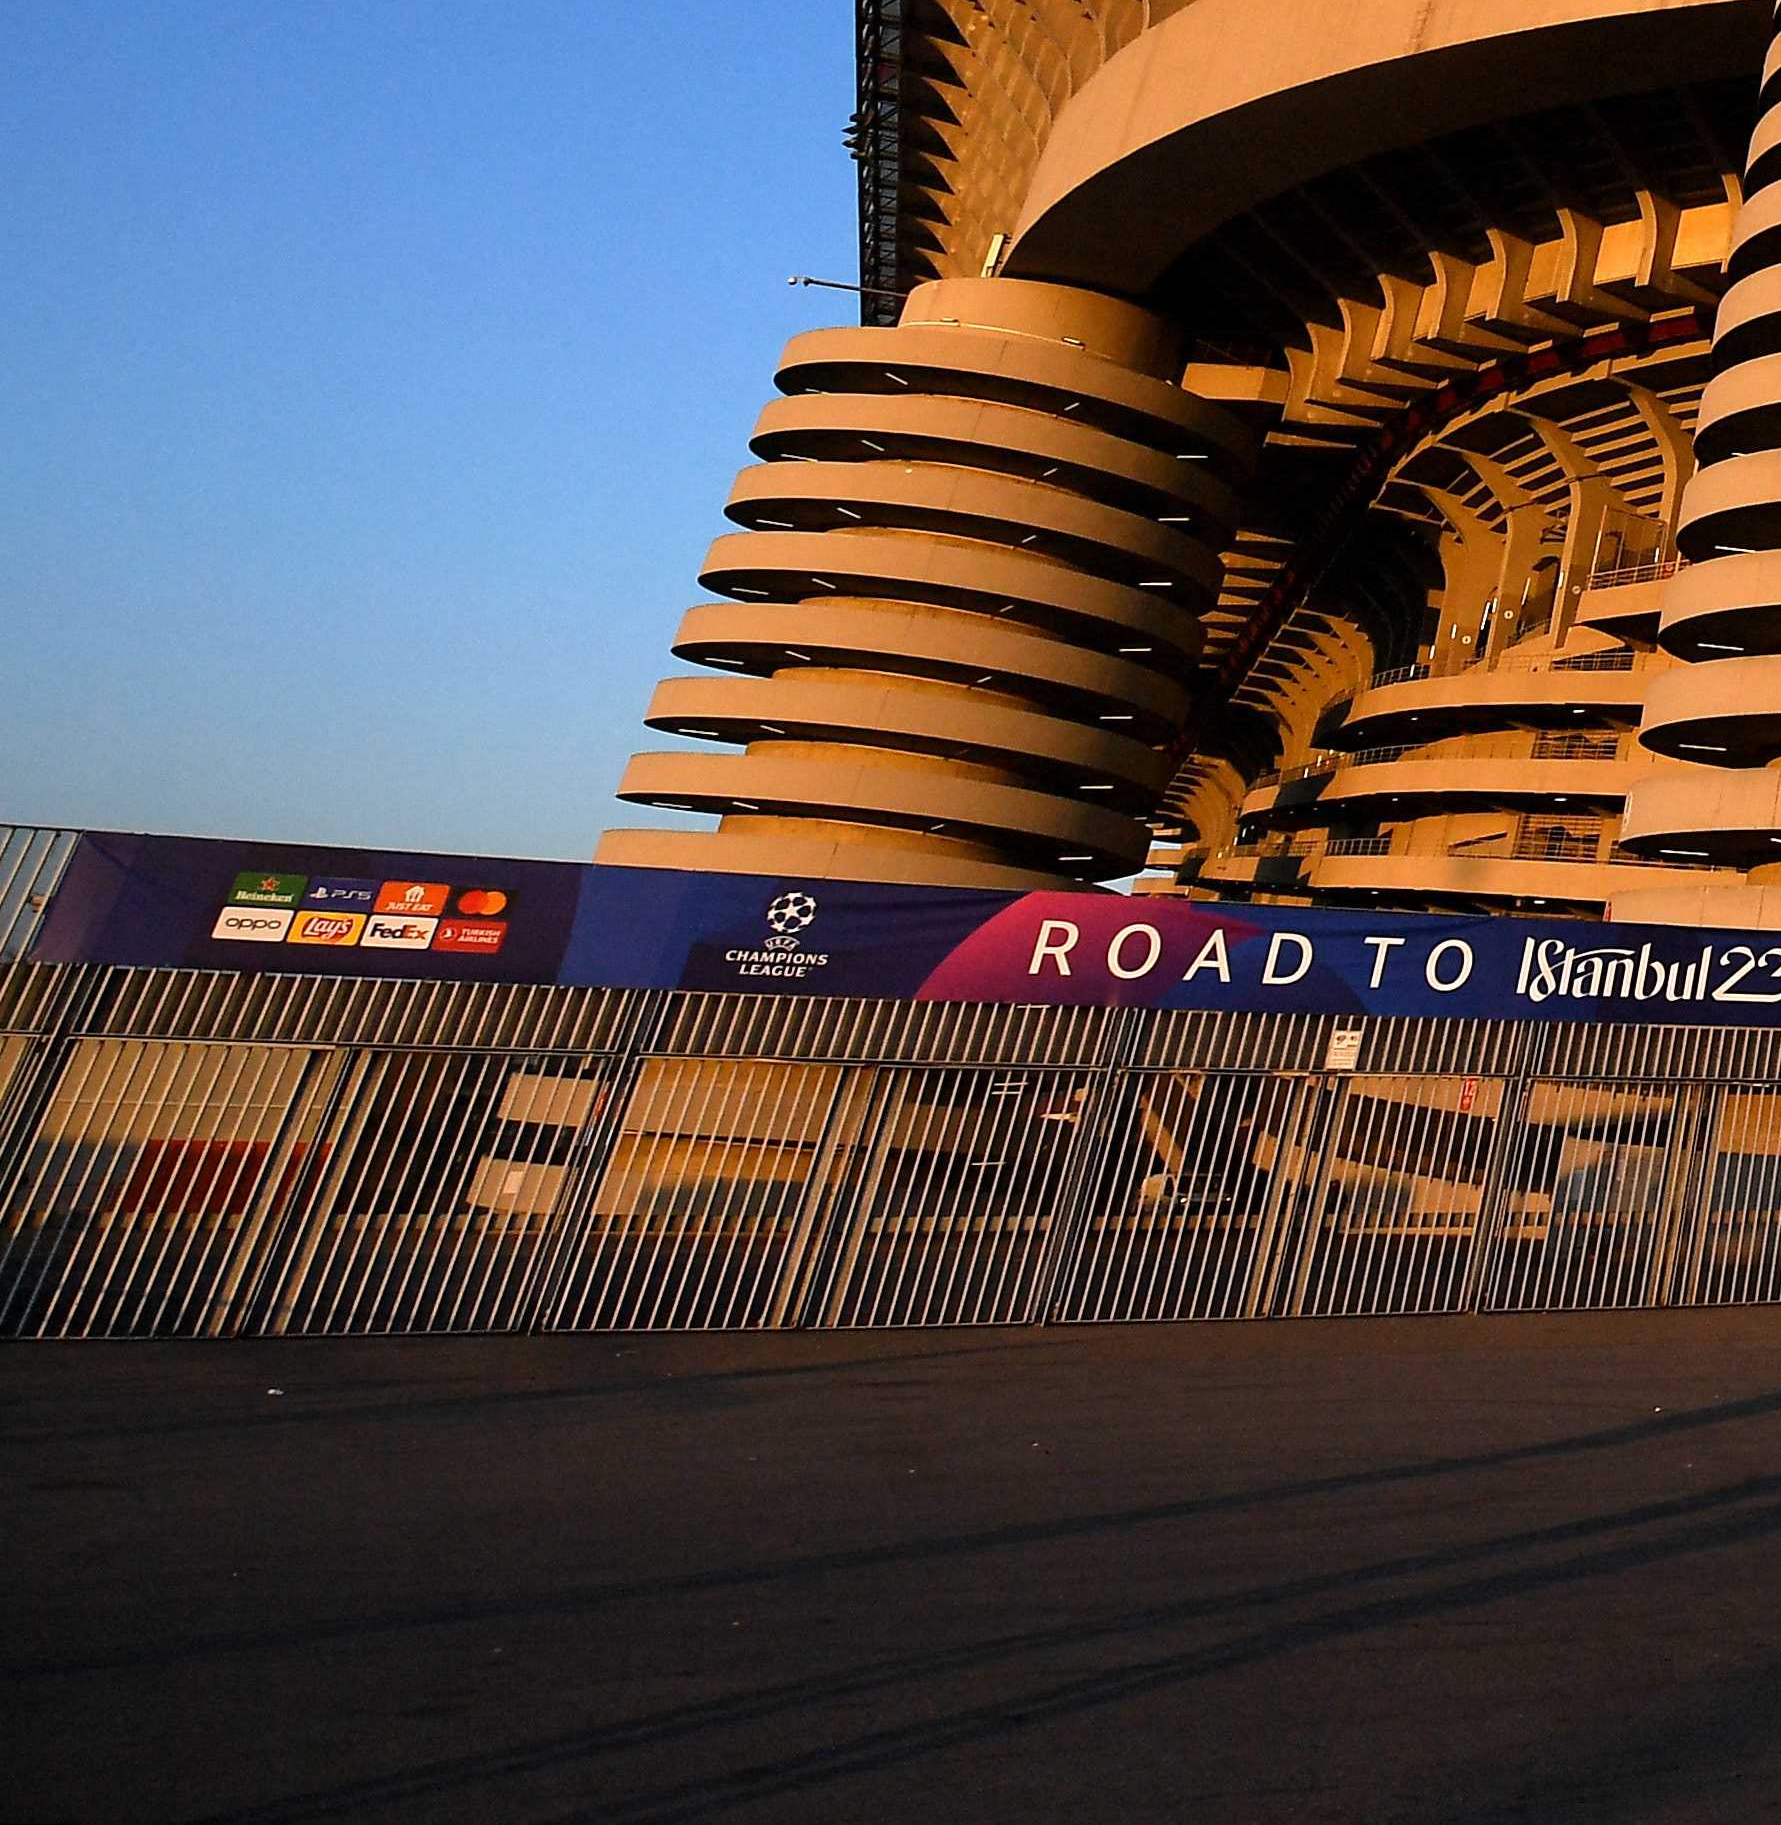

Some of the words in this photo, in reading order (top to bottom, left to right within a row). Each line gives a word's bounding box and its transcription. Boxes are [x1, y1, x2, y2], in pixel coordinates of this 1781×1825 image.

[234, 890, 293, 903] Heineken
[331, 888, 372, 901] PS5
[386, 901, 410, 912] JUST
[411, 903, 433, 913] EAT
[225, 917, 282, 931] oppo
[303, 916, 352, 940] Lay's
[369, 923, 430, 941] FedEx
[461, 928, 502, 937] TURKISH
[764, 936, 799, 951] UEFA
[725, 949, 829, 966] CHAMPIONS
[1028, 919, 1314, 985] ROAD
[1363, 937, 1474, 992] TO
[739, 964, 807, 978] LEAGUE
